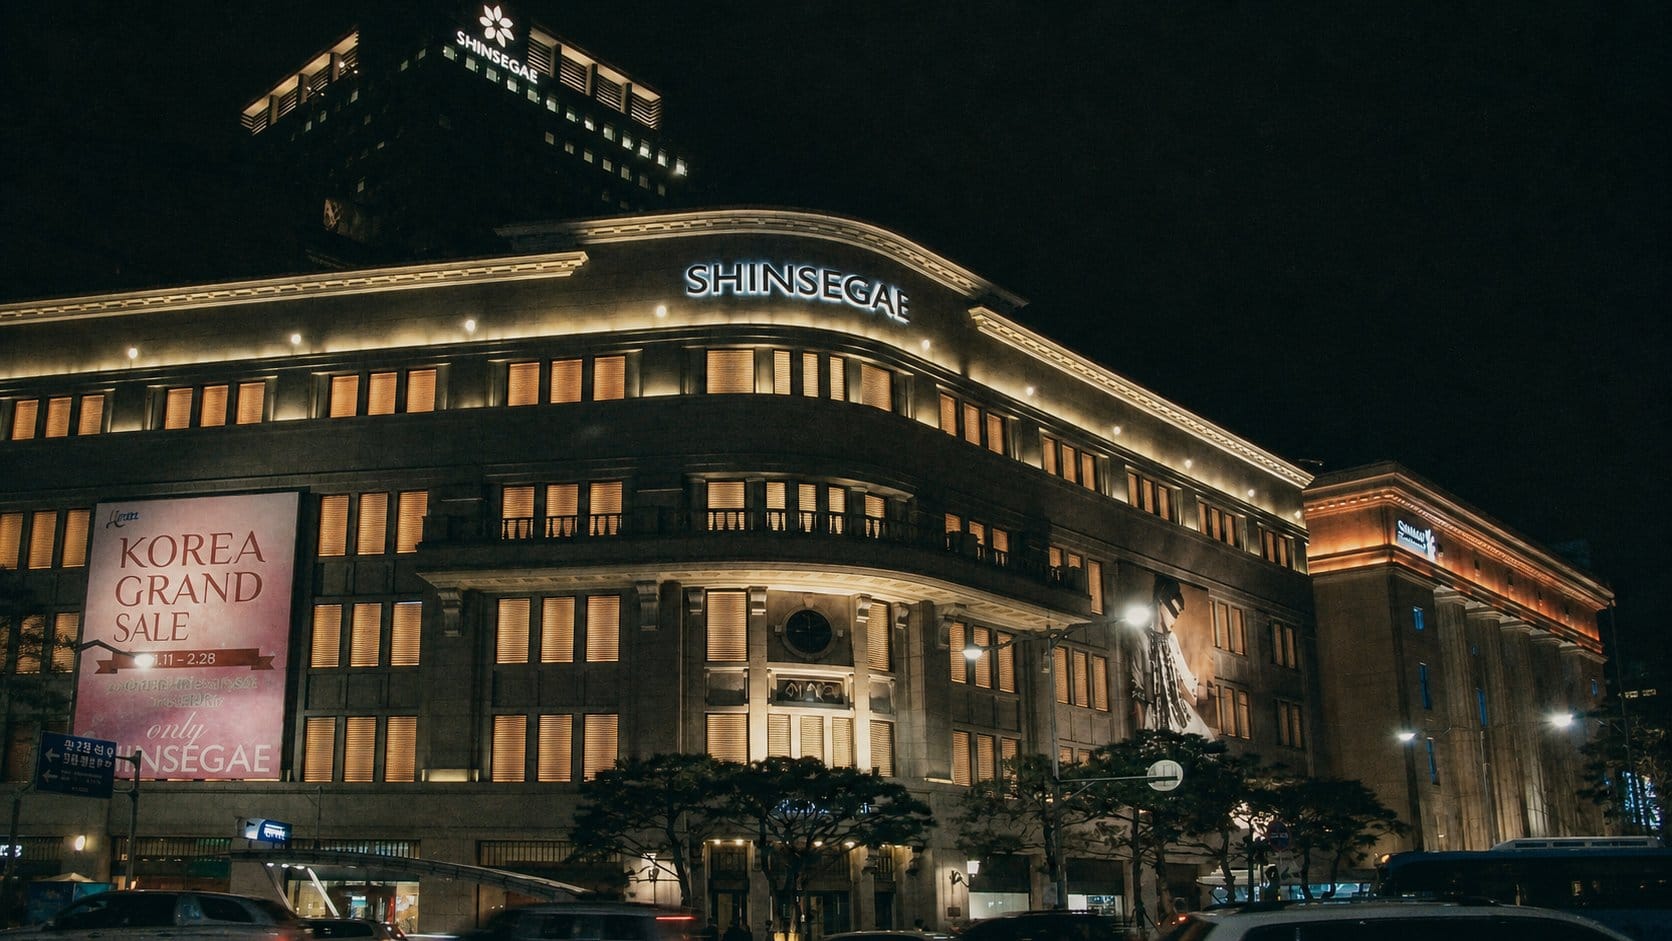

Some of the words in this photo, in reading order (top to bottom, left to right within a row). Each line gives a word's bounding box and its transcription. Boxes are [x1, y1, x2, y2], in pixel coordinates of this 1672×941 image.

[456, 30, 538, 84] SHINSEGAE
[684, 261, 911, 324] SHINSEGAE
[120, 530, 266, 569] KOREA
[115, 571, 263, 607] GRAND
[113, 612, 190, 643] SALE
[187, 652, 216, 665] 2.28
[146, 711, 207, 747] only
[115, 744, 272, 774] INSEGAE
